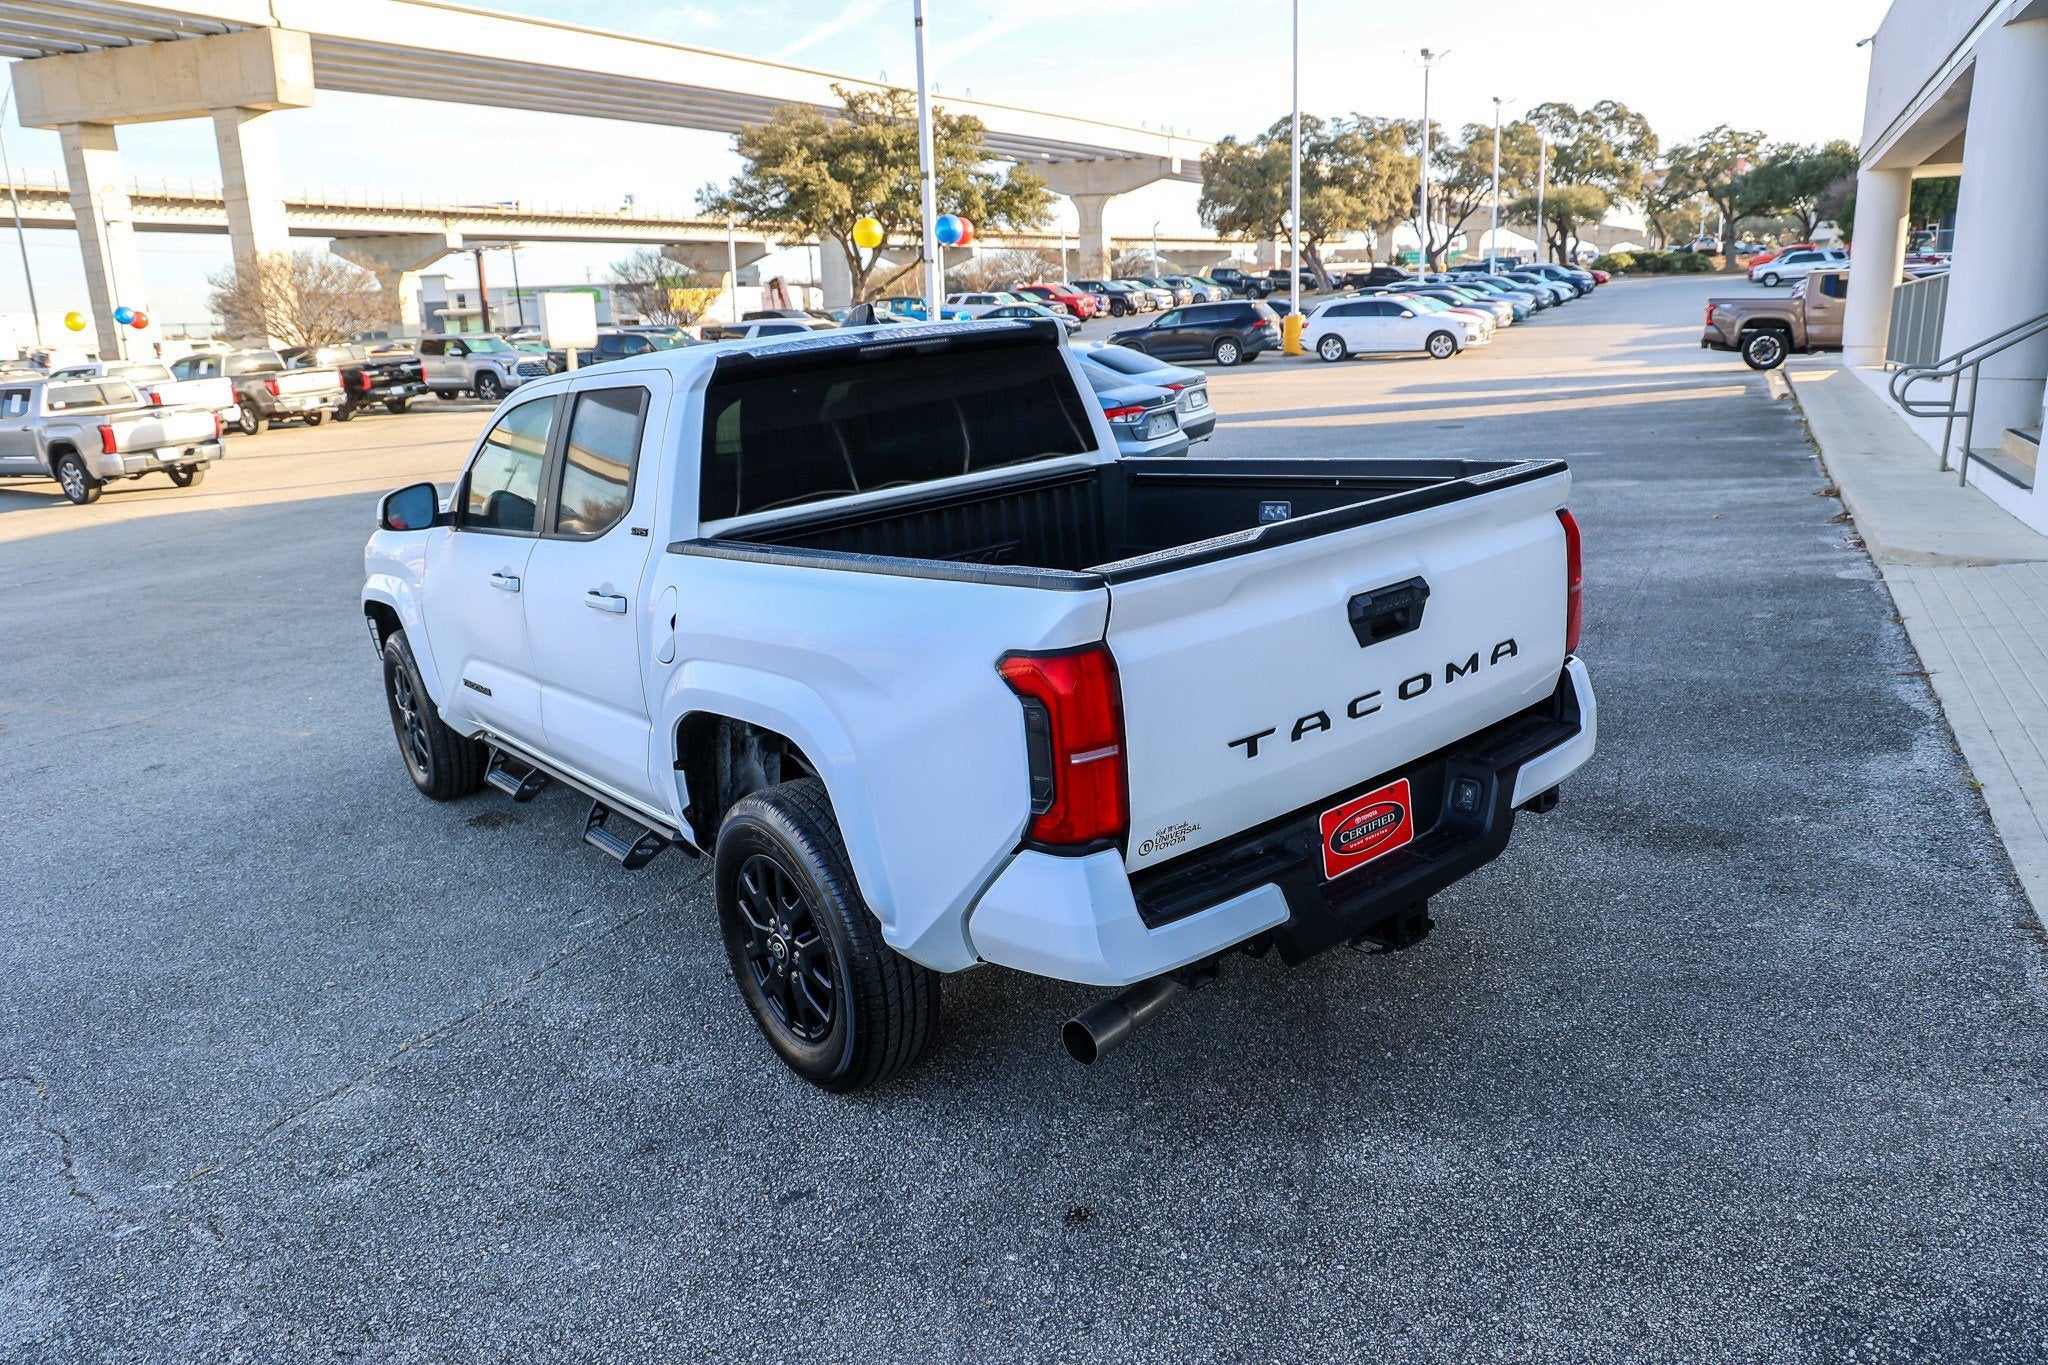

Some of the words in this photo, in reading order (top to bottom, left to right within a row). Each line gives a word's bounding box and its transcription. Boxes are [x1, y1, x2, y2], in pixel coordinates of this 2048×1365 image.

[1228, 638, 1518, 758] TACOMA
[1361, 810, 1378, 821] TOYOTA
[1155, 823, 1202, 844] UNIVERSAL
[1154, 836, 1186, 851] TOYOTA
